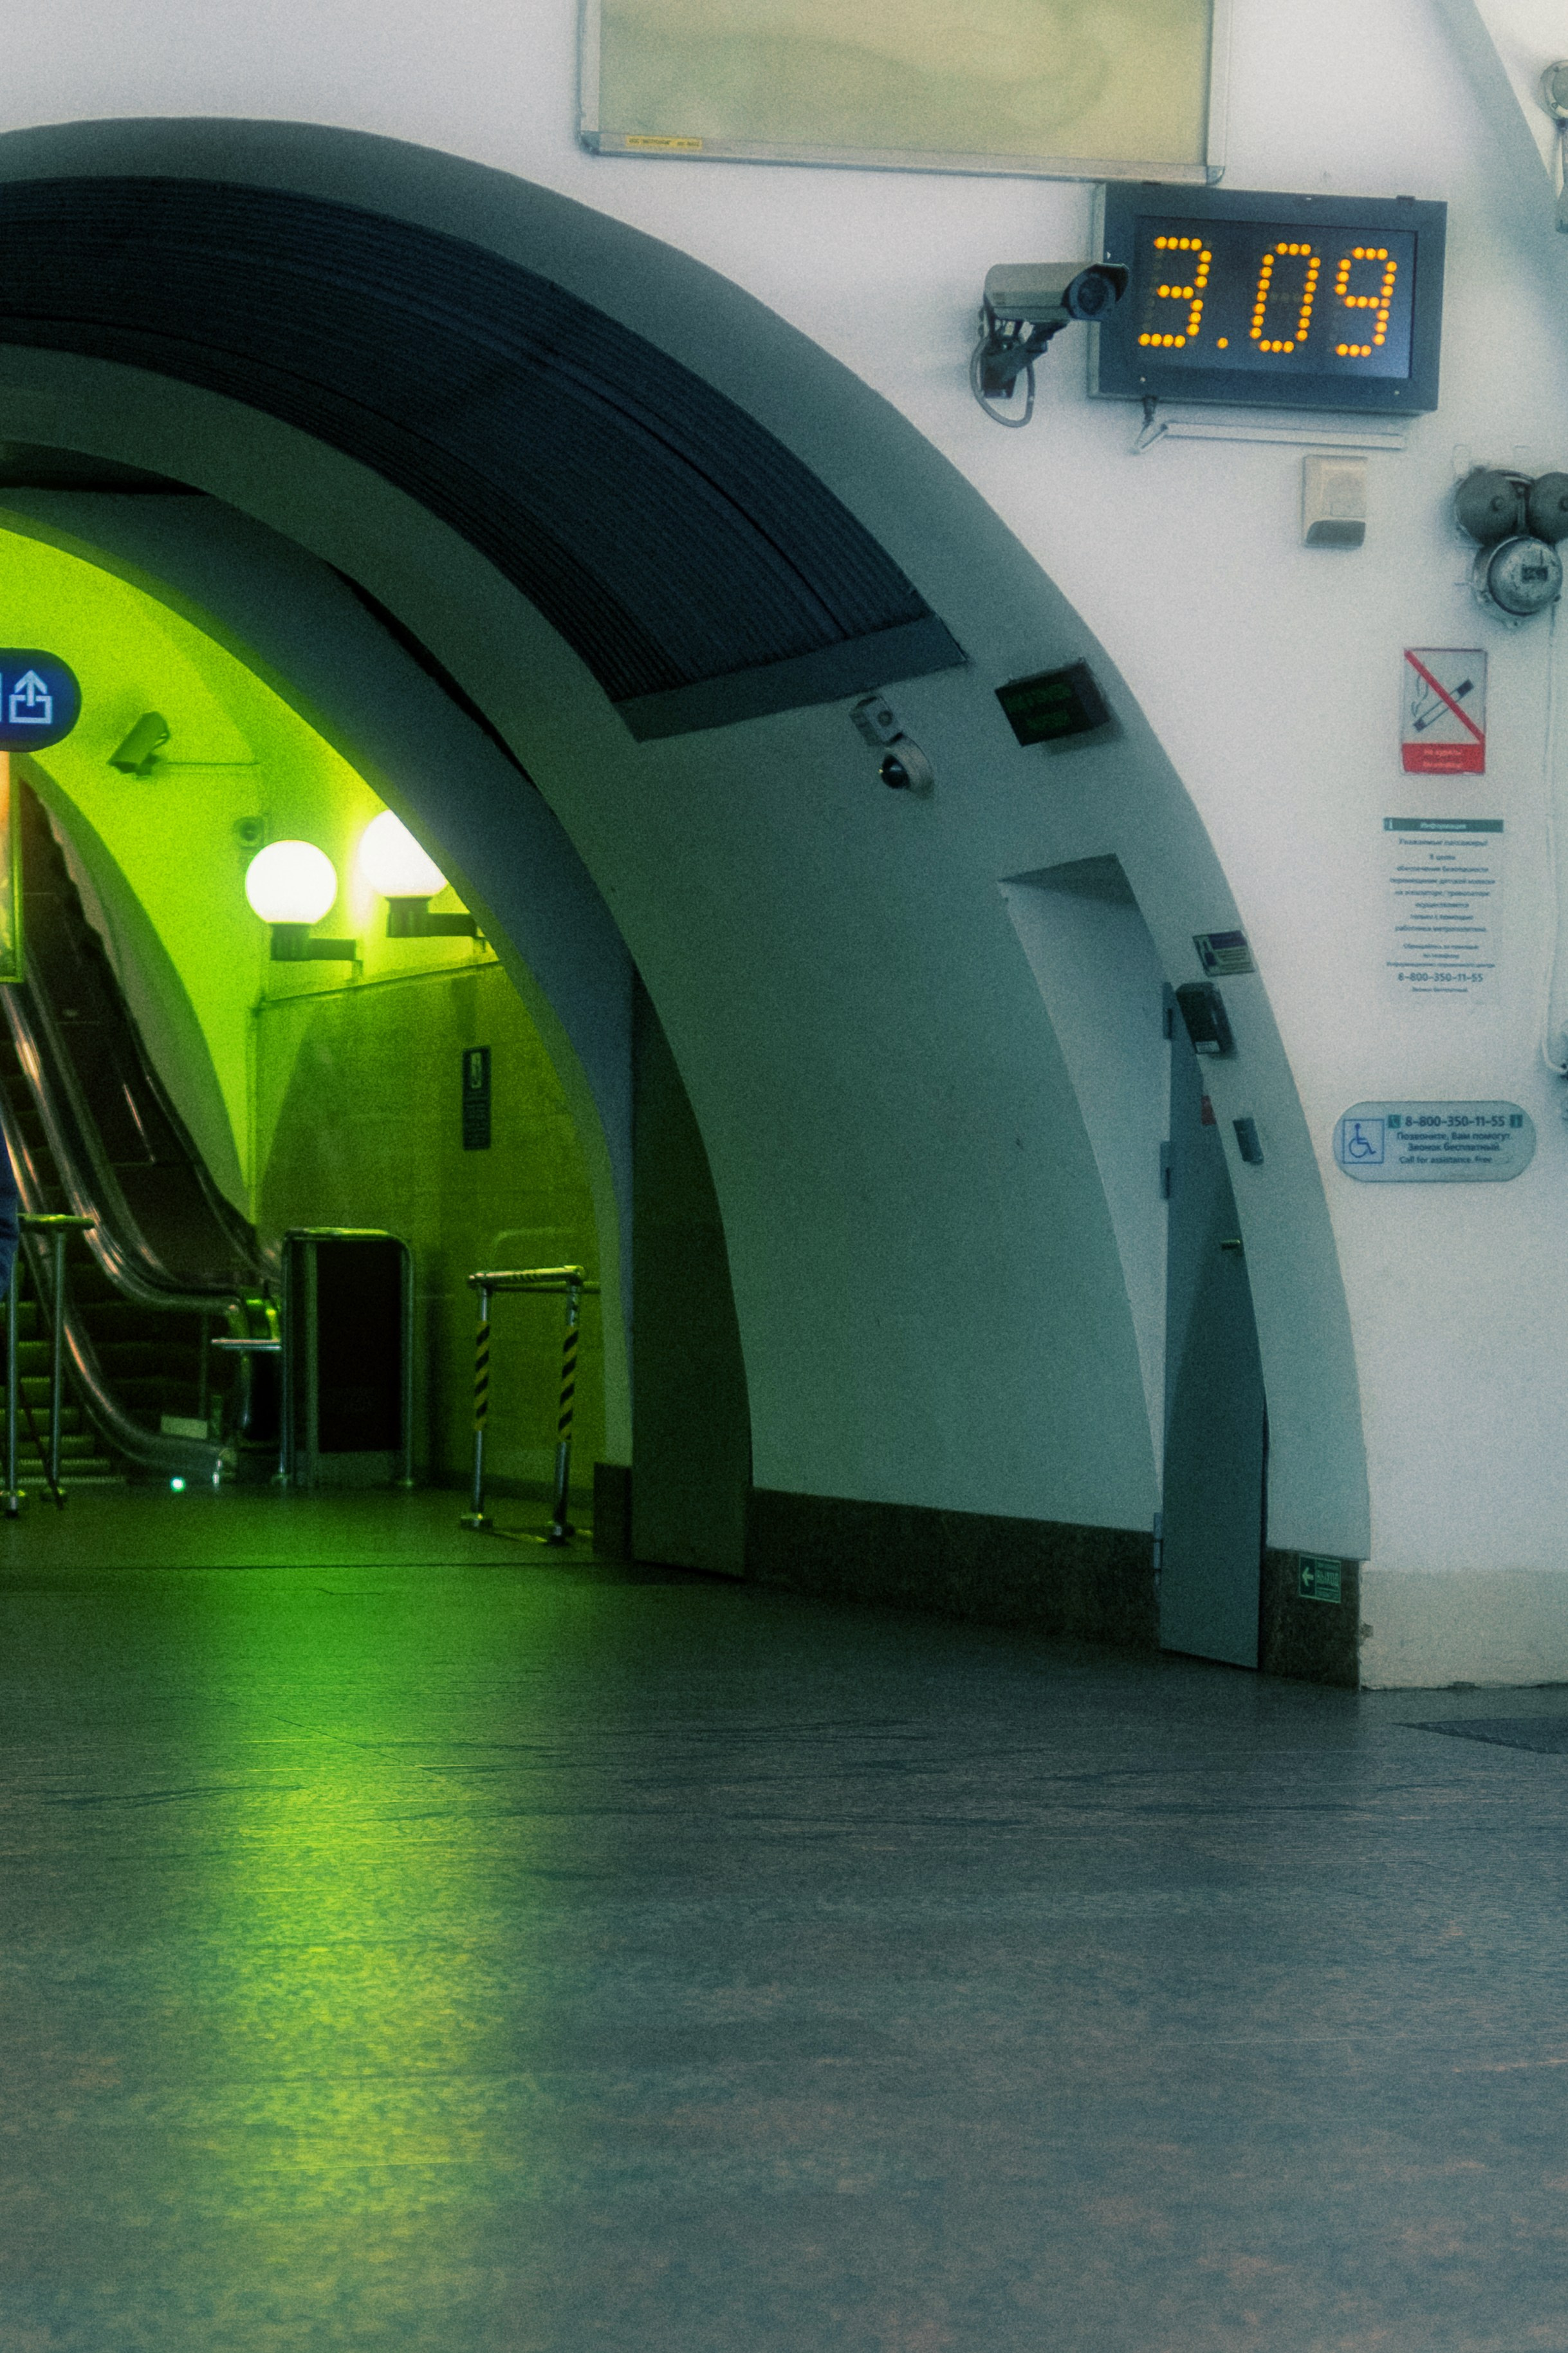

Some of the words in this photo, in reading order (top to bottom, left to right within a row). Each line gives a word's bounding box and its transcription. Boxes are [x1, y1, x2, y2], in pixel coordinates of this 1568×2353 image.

[1138, 236, 1397, 357] 3.09
[1398, 972, 1484, 982] 8-800-350-11-55
[1405, 1115, 1505, 1127] 8-800-350-11-55
